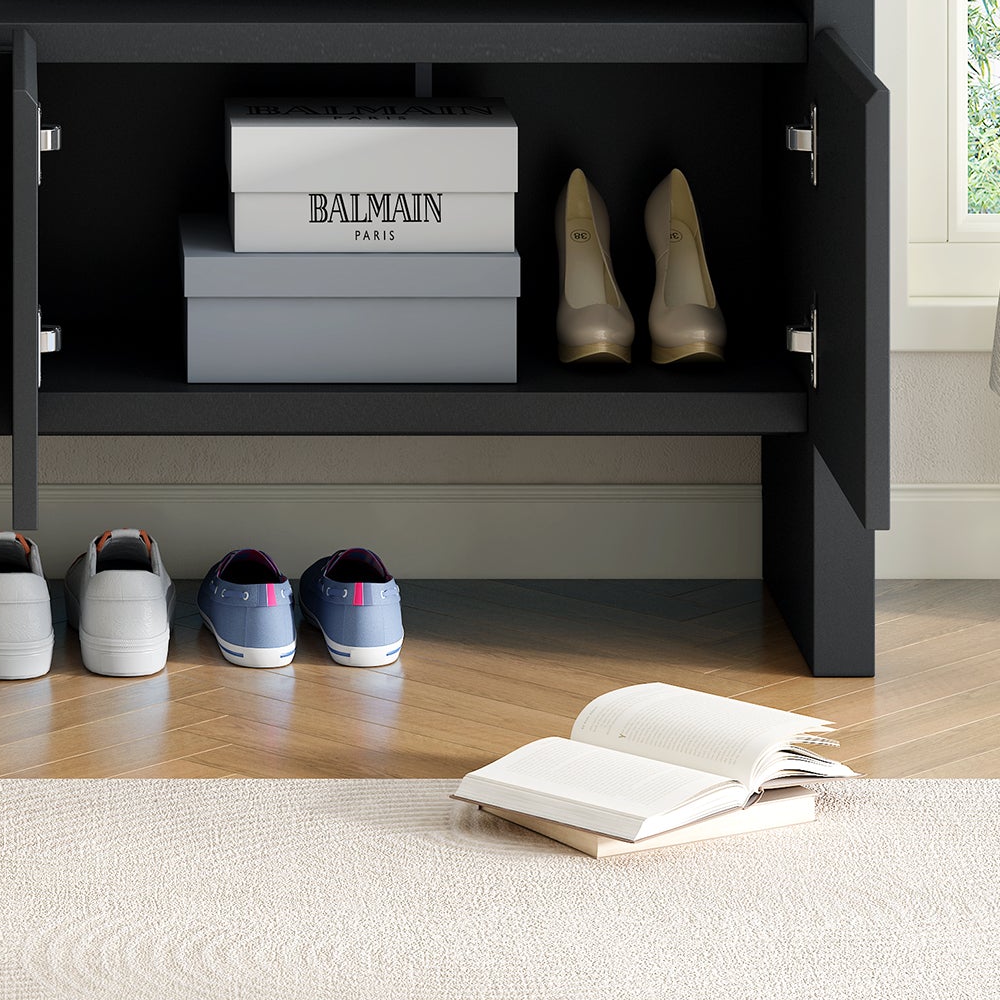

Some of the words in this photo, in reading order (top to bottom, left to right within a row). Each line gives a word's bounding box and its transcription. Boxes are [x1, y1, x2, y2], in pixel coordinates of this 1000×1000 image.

[246, 105, 494, 116] BALMAIN
[308, 193, 443, 223] BALMAIN
[354, 230, 396, 241] PARIS
